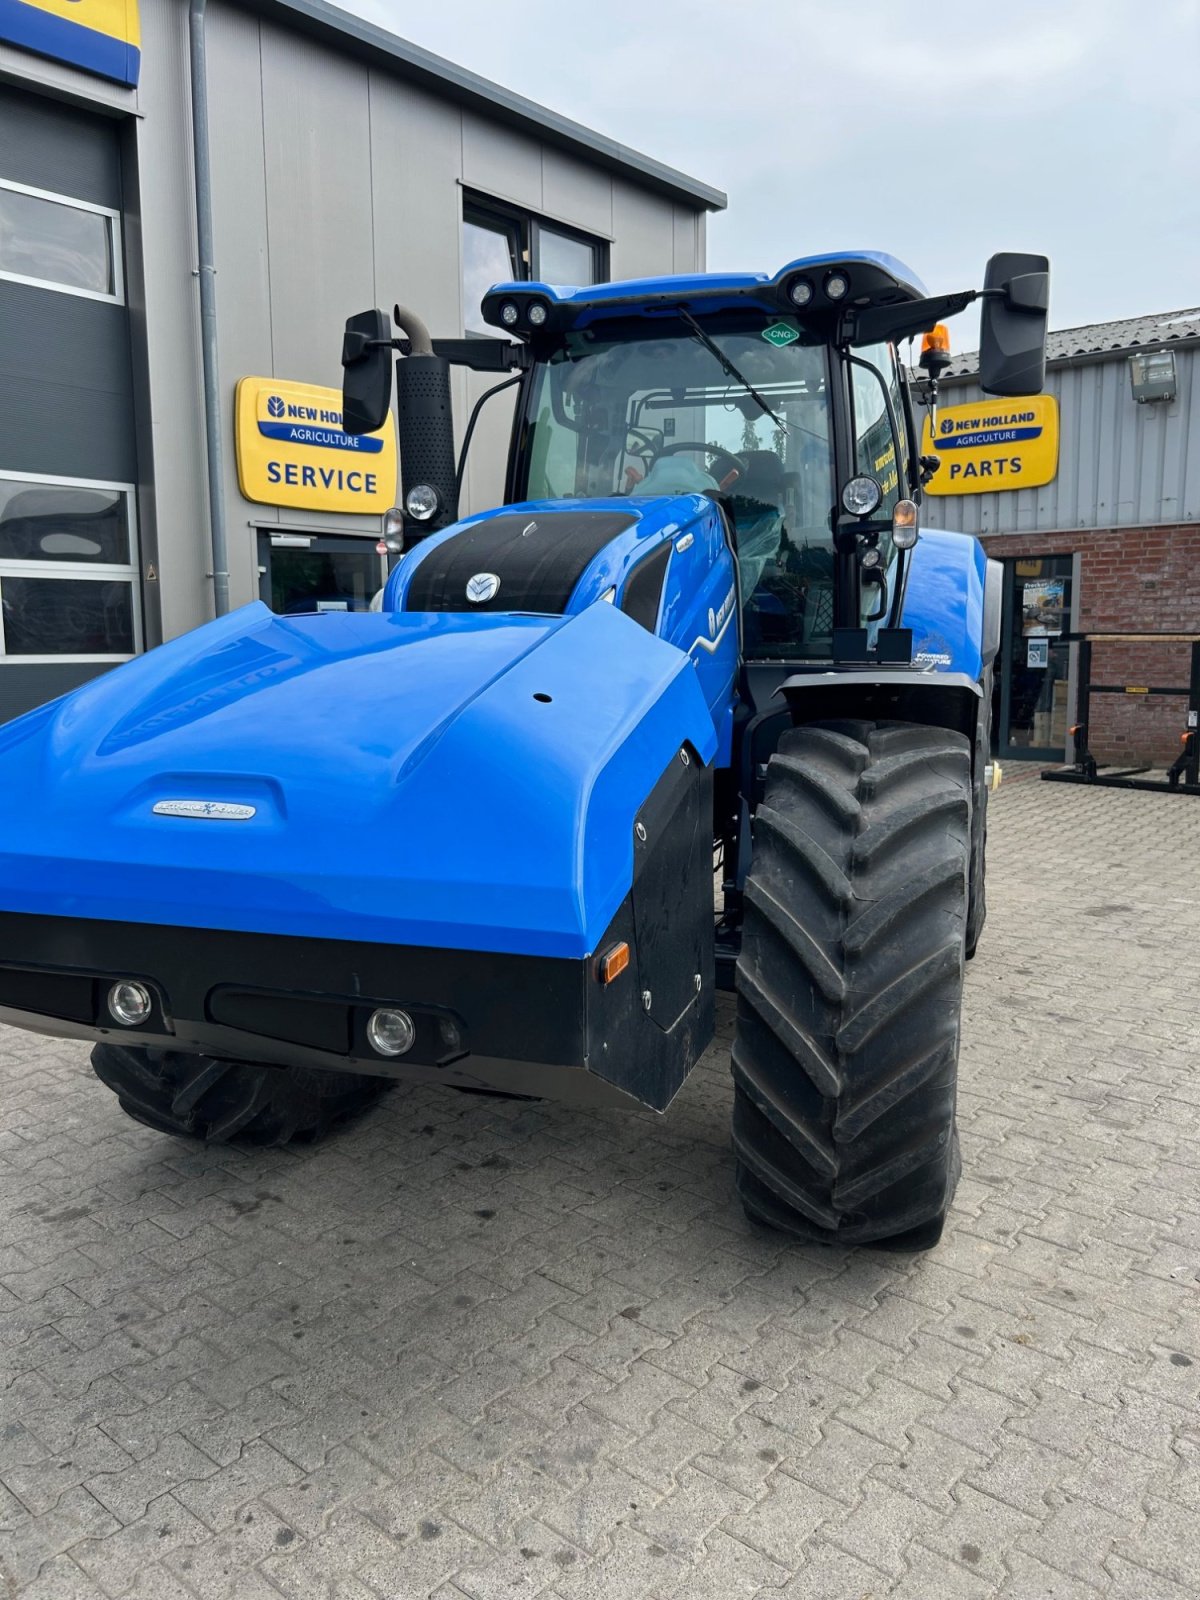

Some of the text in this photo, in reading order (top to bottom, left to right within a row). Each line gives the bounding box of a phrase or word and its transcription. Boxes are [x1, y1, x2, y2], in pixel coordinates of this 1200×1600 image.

[770, 330, 791, 339] CNG
[288, 404, 317, 421] NEW
[955, 411, 1035, 431] NEW HOLLAND
[290, 428, 360, 448] AGRICULTURE
[956, 430, 1017, 446] AGRICULTURE
[267, 461, 377, 494] SERVICE
[950, 457, 1022, 480] PARTS
